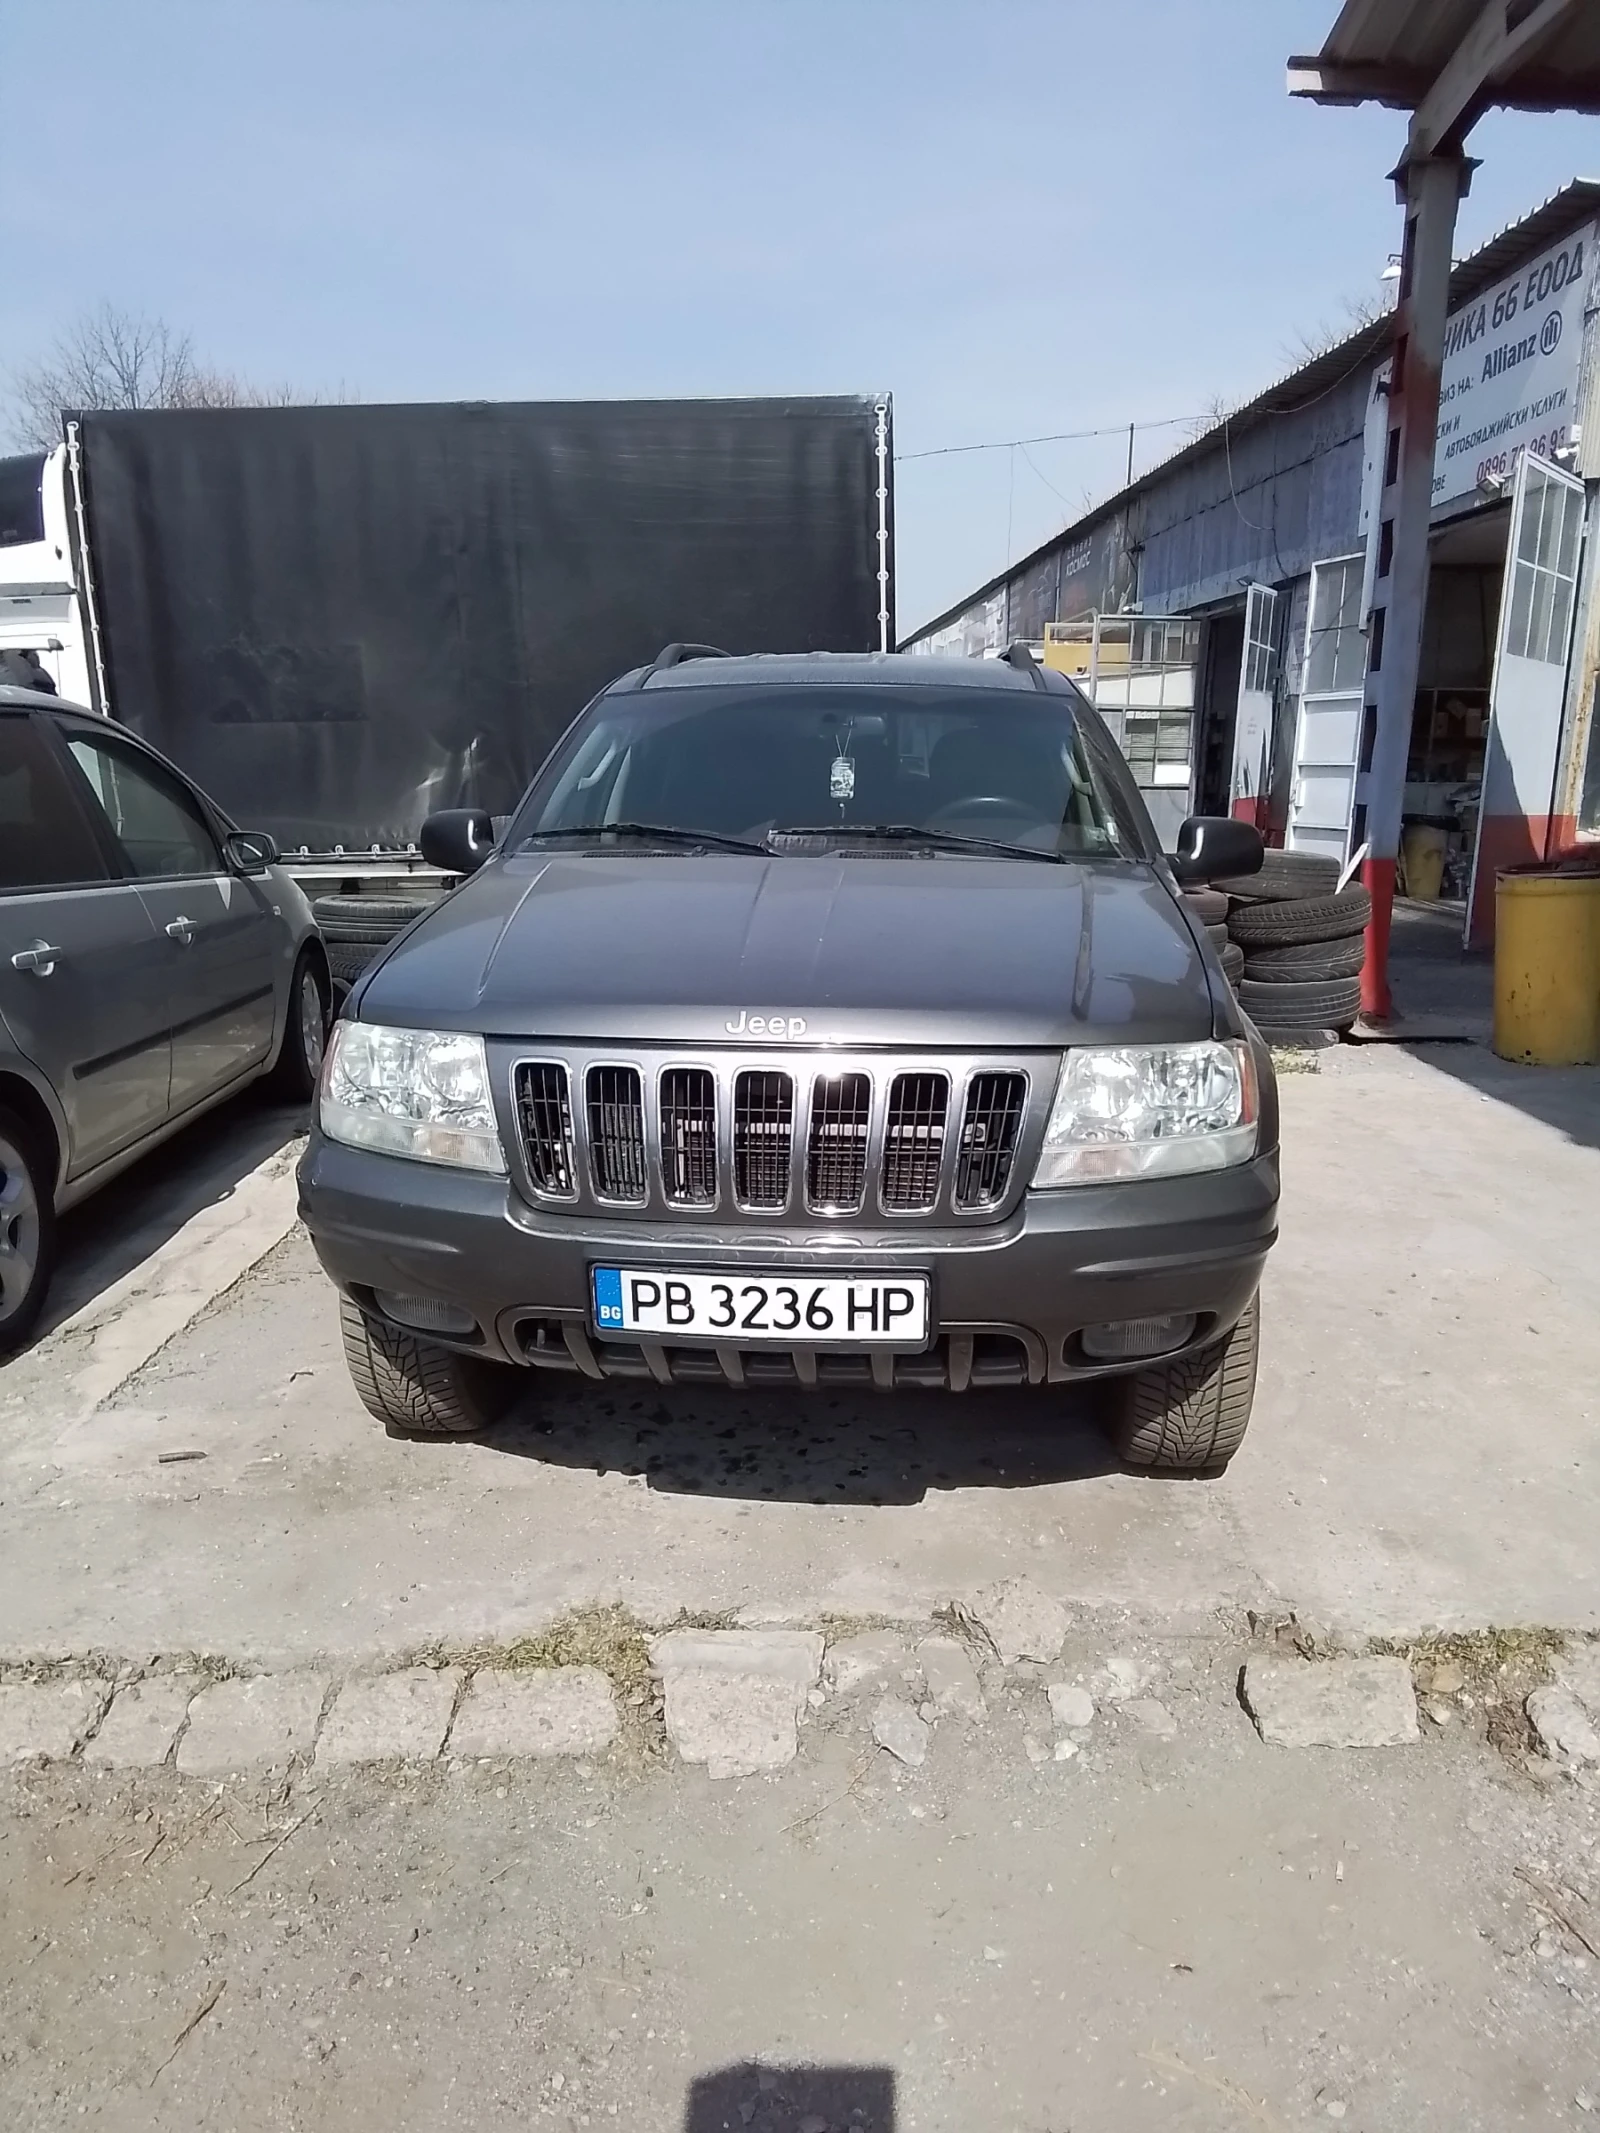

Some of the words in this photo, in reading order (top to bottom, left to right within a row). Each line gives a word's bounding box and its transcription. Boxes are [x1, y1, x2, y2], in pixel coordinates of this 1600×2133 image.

[1524, 241, 1584, 312] ЕООД
[1481, 333, 1537, 383] Allianz
[1444, 405, 1530, 461] АВТОБОЯДЖИЙСКИ
[1531, 387, 1567, 420] УСЛУГИ
[725, 1010, 807, 1040] Jeep
[601, 1305, 621, 1320] BG
[630, 1279, 695, 1325] PB
[709, 1284, 834, 1330] 3236
[847, 1287, 914, 1332] HP
